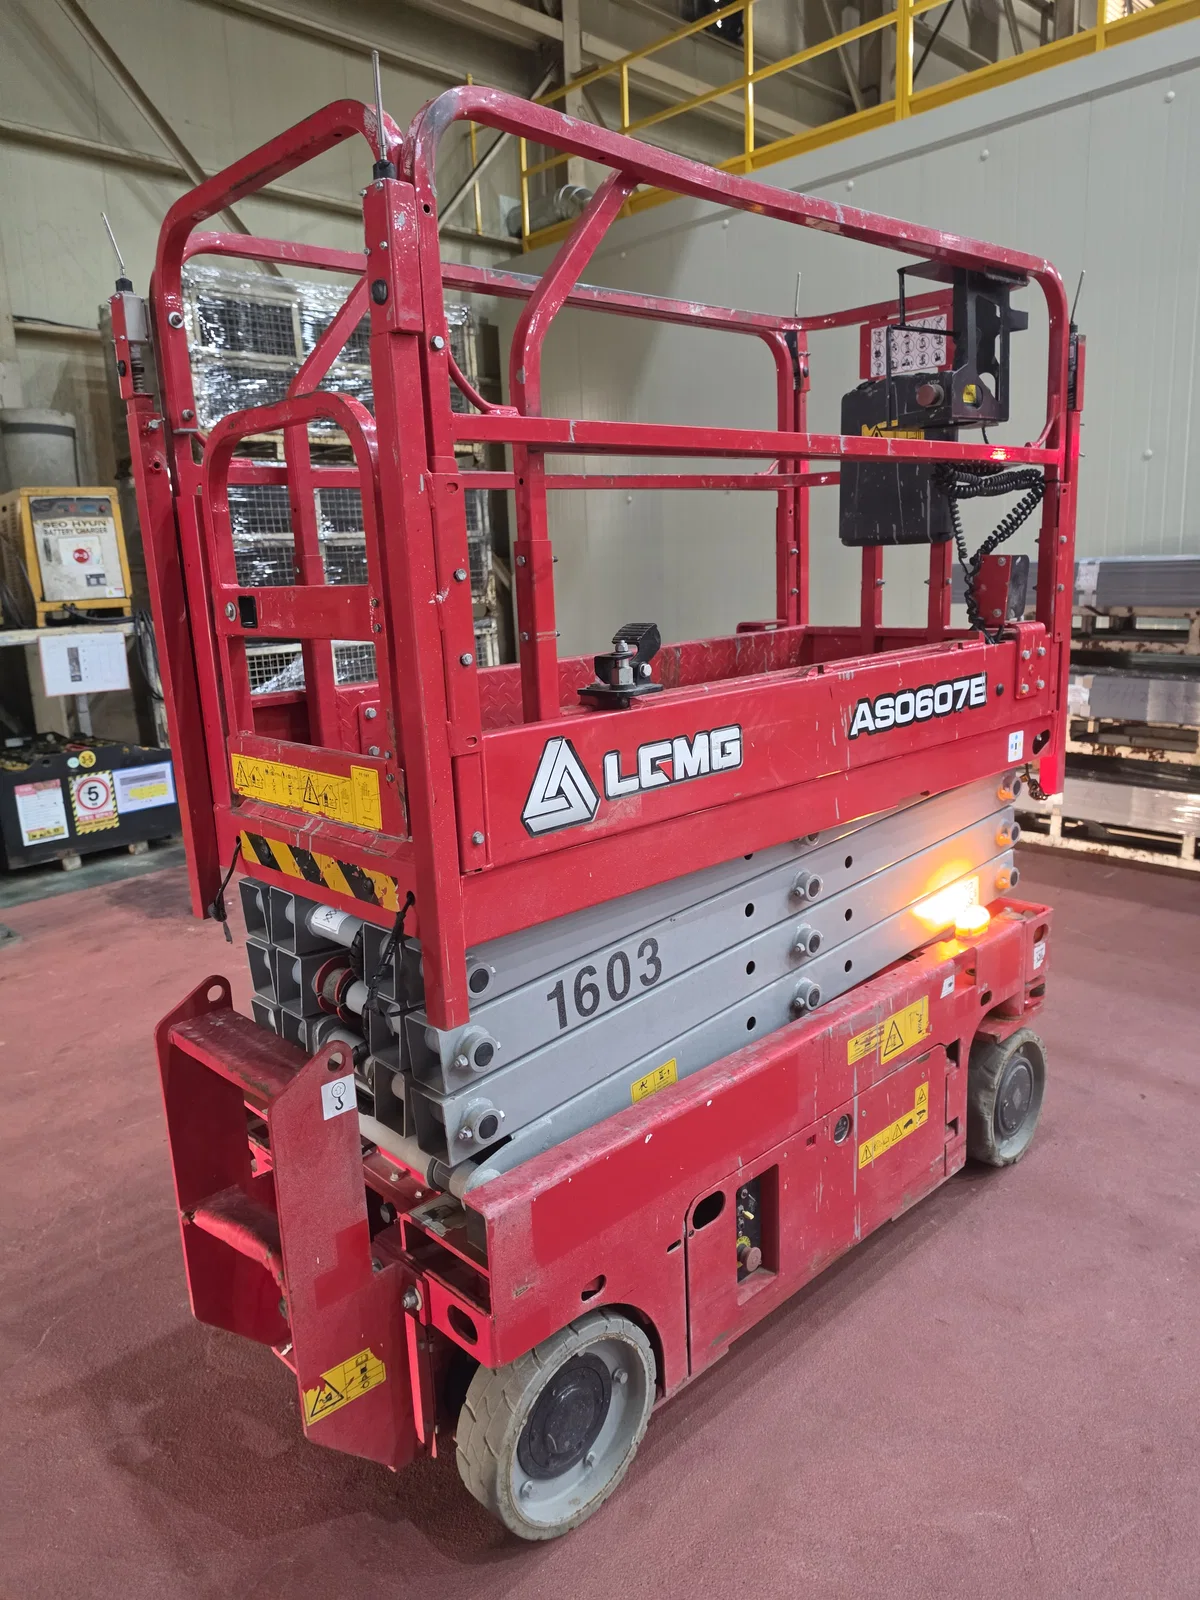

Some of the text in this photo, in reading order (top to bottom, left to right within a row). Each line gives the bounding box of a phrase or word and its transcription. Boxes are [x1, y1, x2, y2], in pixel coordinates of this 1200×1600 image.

[43, 527, 108, 536] BATTERY CHARGER
[847, 673, 987, 739] AS0607E
[87, 786, 99, 801] 5
[546, 937, 662, 1030] 1603
